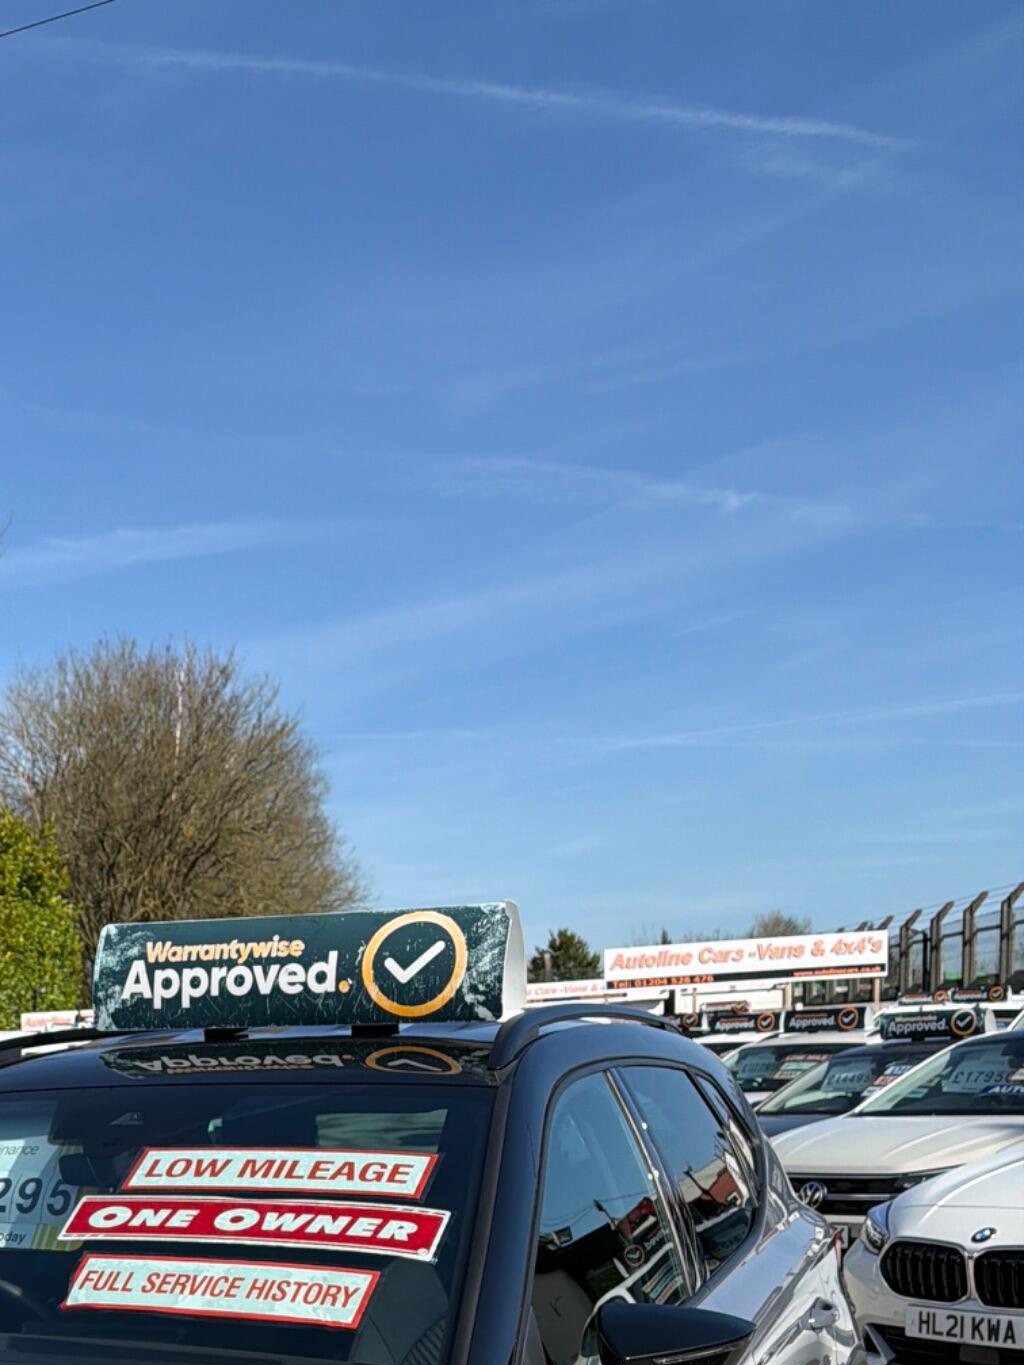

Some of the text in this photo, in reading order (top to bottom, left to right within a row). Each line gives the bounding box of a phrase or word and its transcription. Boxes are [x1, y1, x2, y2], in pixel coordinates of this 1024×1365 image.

[146, 935, 305, 964] Warrantywise
[609, 950, 693, 971] Autoline
[698, 947, 744, 964] Cars
[811, 939, 826, 957] &
[830, 936, 882, 955] 4x4's
[121, 950, 350, 1009] Approved.
[952, 1071, 1010, 1084] £1795
[144, 1158, 414, 1184] LOW MILEAGE
[87, 1206, 419, 1241] ONE OWNER
[78, 1270, 361, 1308] FULL SERVICE HISTORY
[918, 1310, 1017, 1344] HL21 KWA
